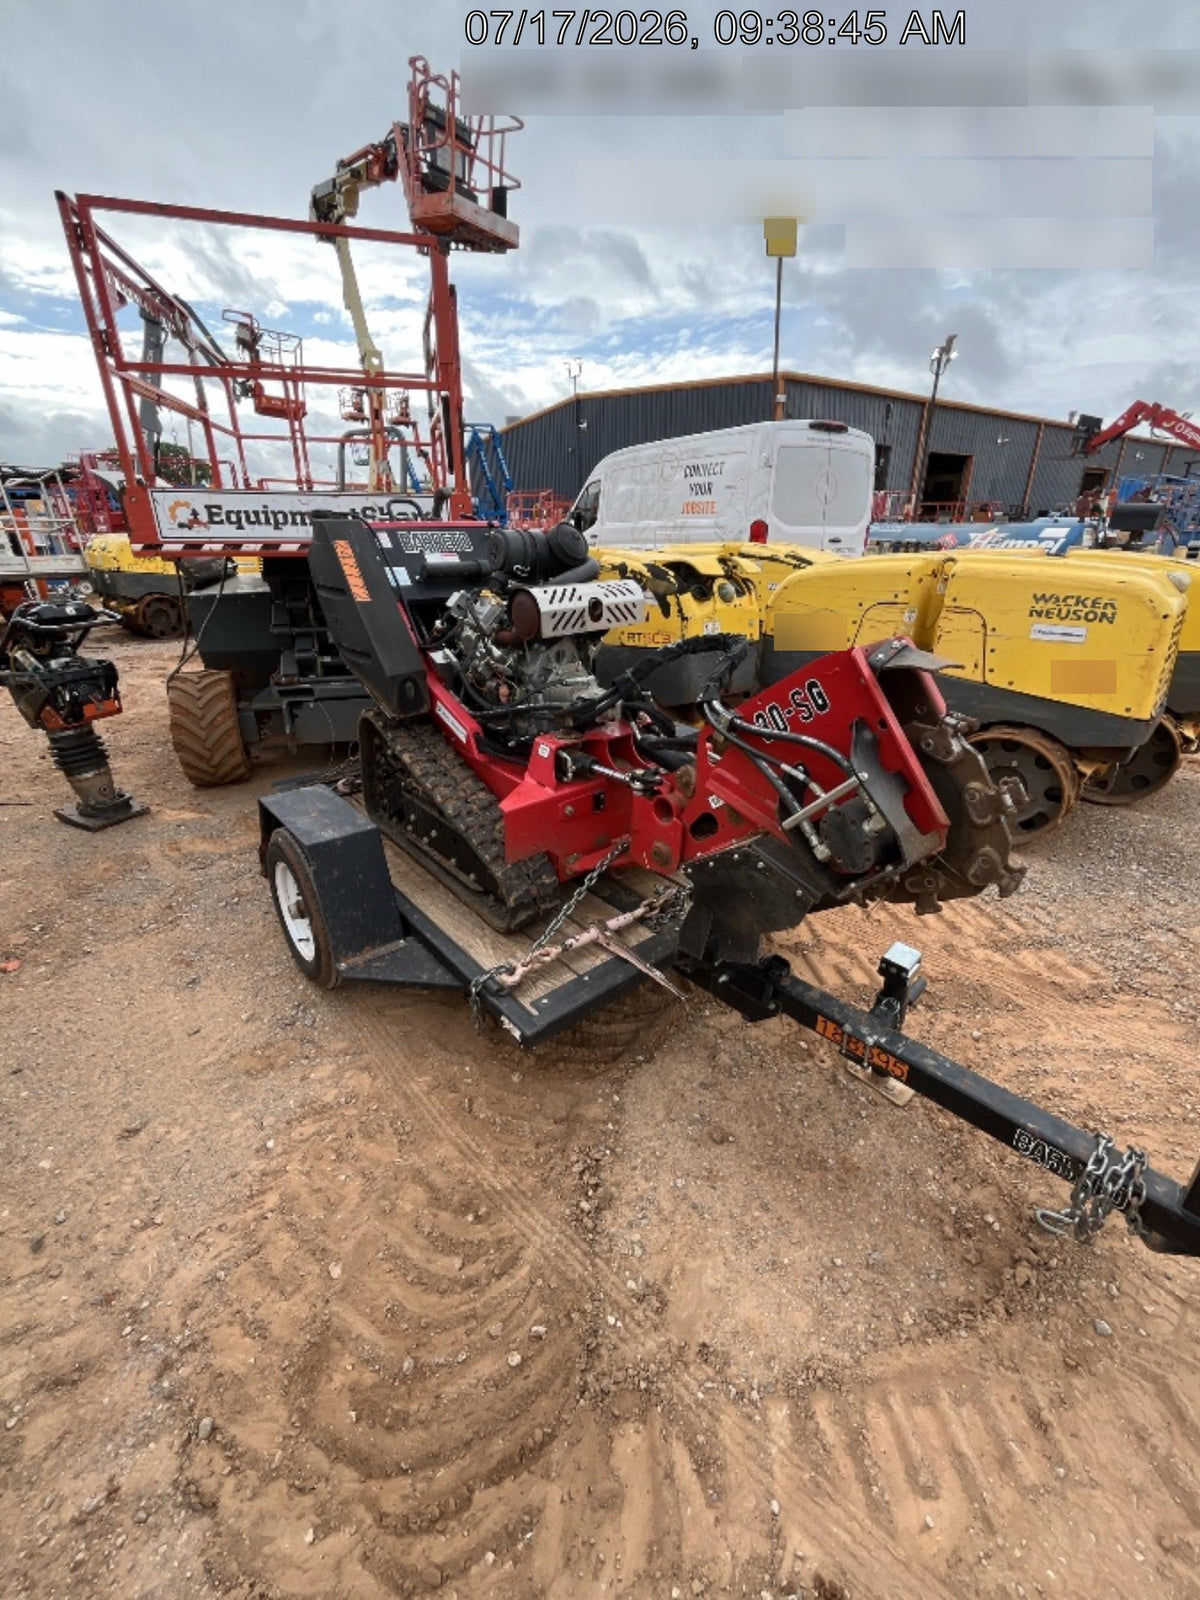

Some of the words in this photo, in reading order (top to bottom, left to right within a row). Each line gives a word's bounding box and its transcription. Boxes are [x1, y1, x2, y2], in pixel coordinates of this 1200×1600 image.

[683, 461, 726, 479] CONNECT
[689, 481, 714, 497] YOUR
[681, 500, 717, 515] JOBSITE
[1032, 592, 1118, 611] WACKER
[1028, 605, 1117, 625] NEUSON
